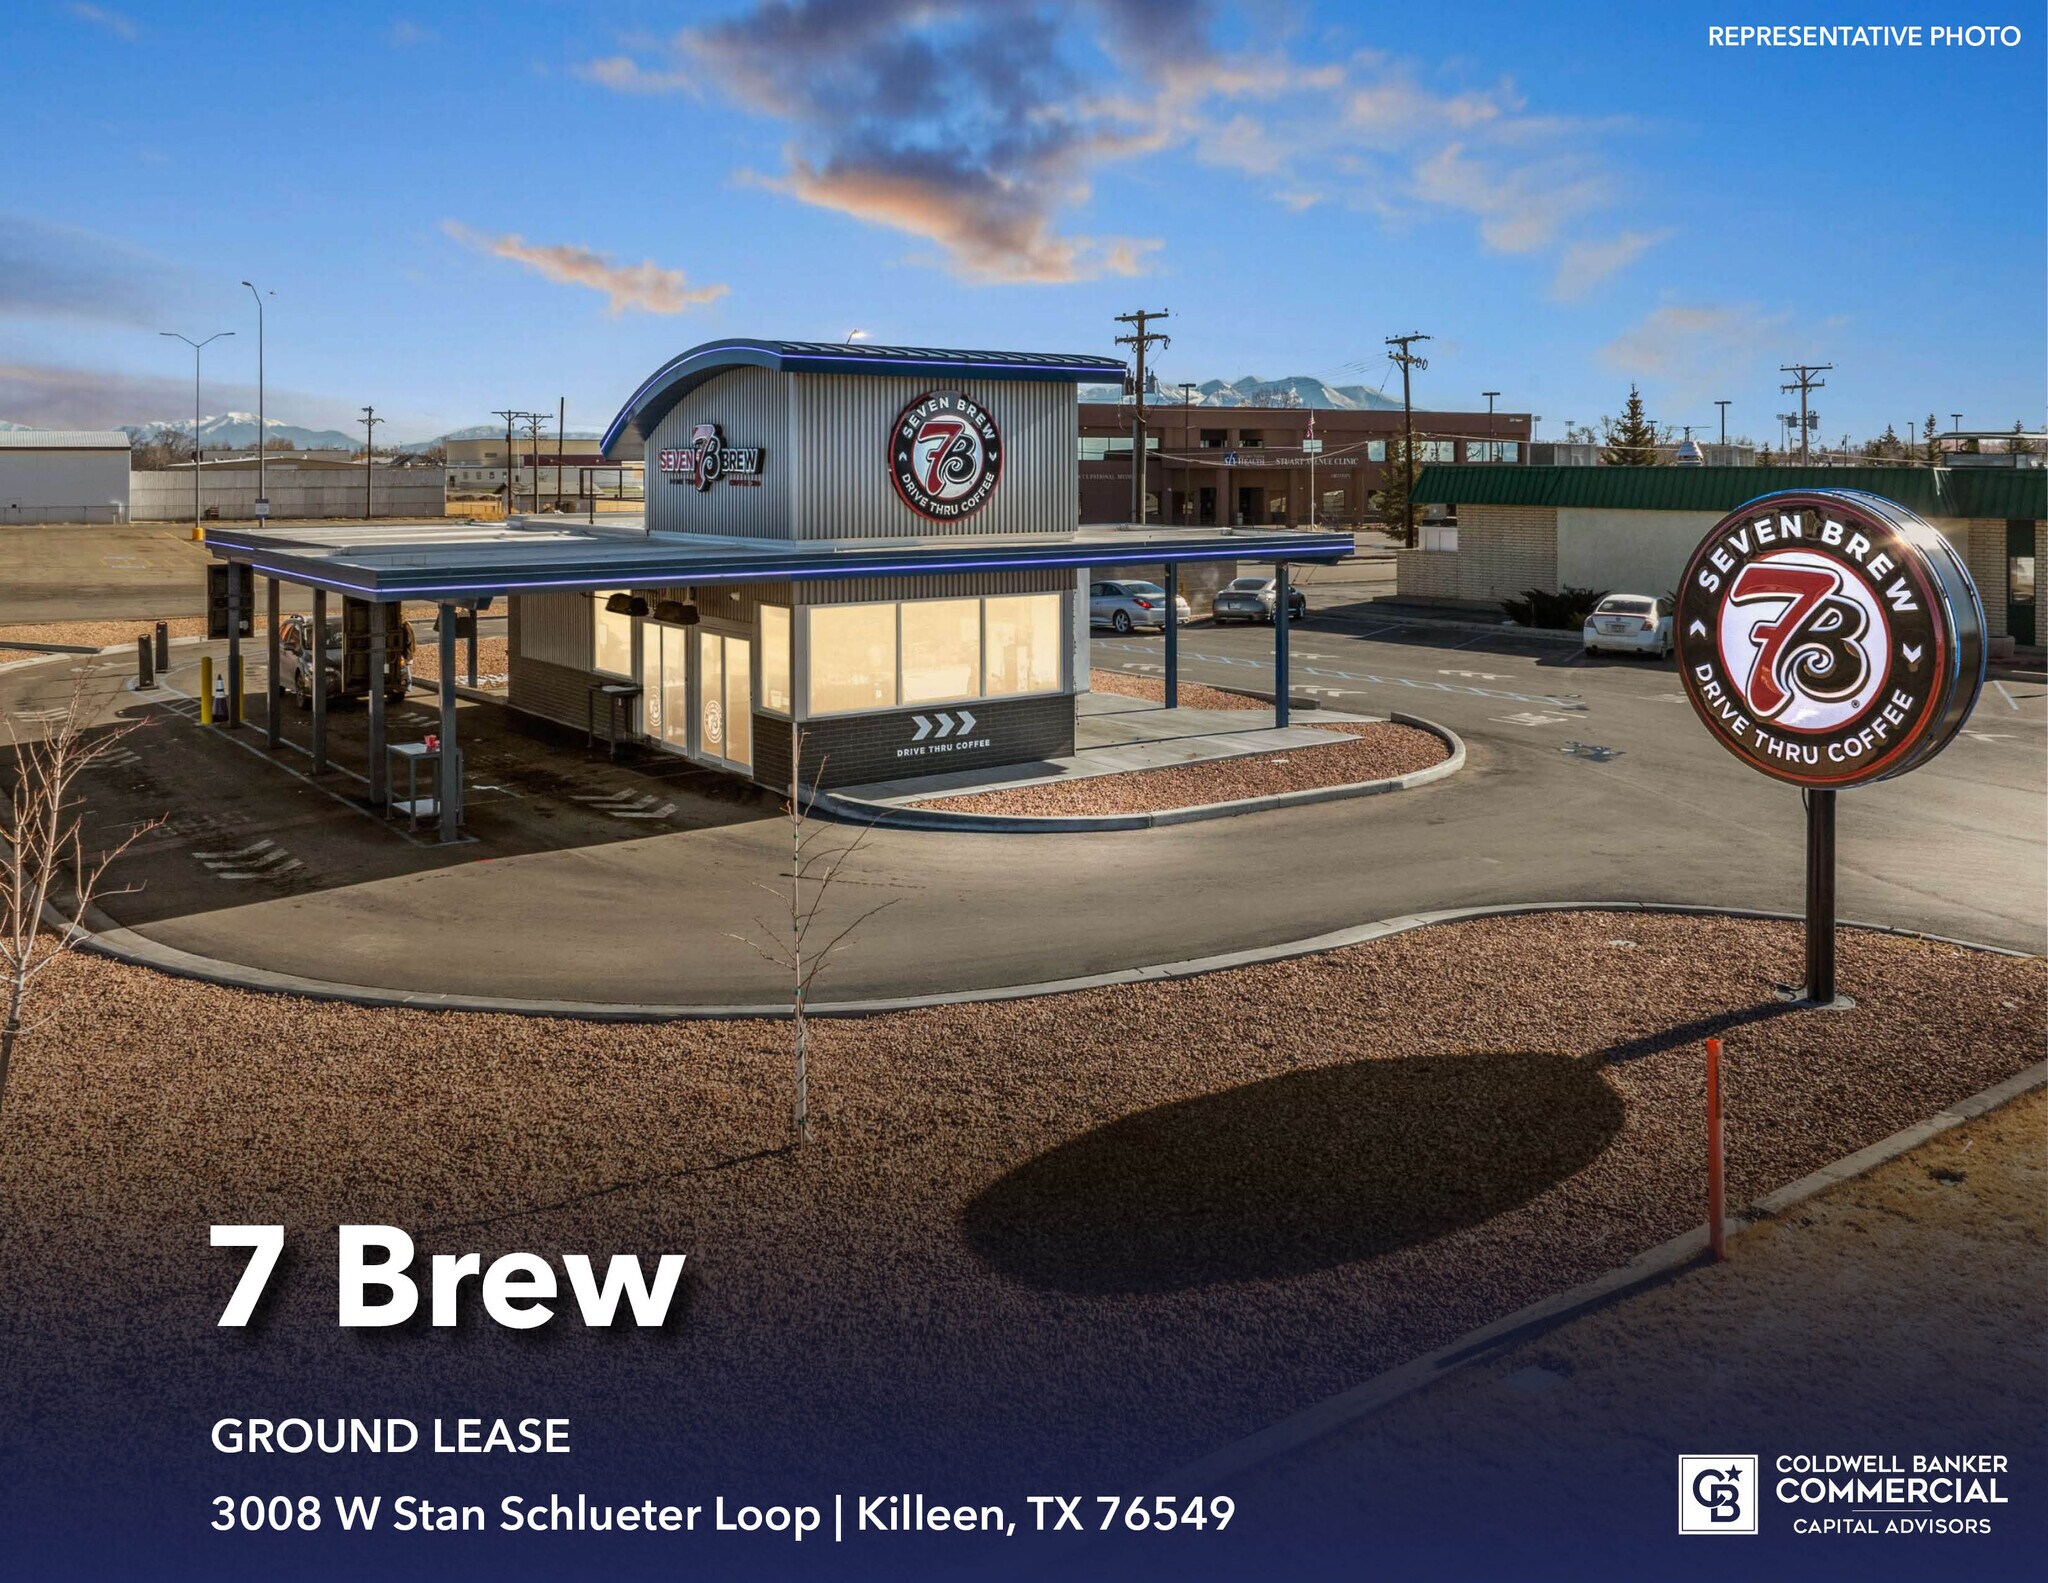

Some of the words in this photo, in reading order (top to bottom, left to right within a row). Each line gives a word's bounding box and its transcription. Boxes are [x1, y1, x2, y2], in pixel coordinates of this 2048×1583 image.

[903, 397, 950, 438] SEVEN
[957, 398, 996, 440] BREW
[660, 449, 695, 473] SEVEN
[721, 448, 759, 474] BREW
[1275, 457, 1304, 466] STUART
[1334, 457, 1360, 466] CLINIC
[901, 473, 927, 507] DRIVE
[929, 501, 959, 516] THRU
[961, 473, 995, 512] COFFEE
[1698, 514, 1803, 593] SEVEN
[1821, 521, 1919, 614] BREW
[1695, 663, 1751, 737] DRIVE
[1754, 728, 1820, 765] THRU
[1827, 688, 1914, 763] COFFEE
[896, 746, 926, 758] DRIVE
[928, 743, 953, 754] THRU
[956, 739, 991, 751] COFFEE
